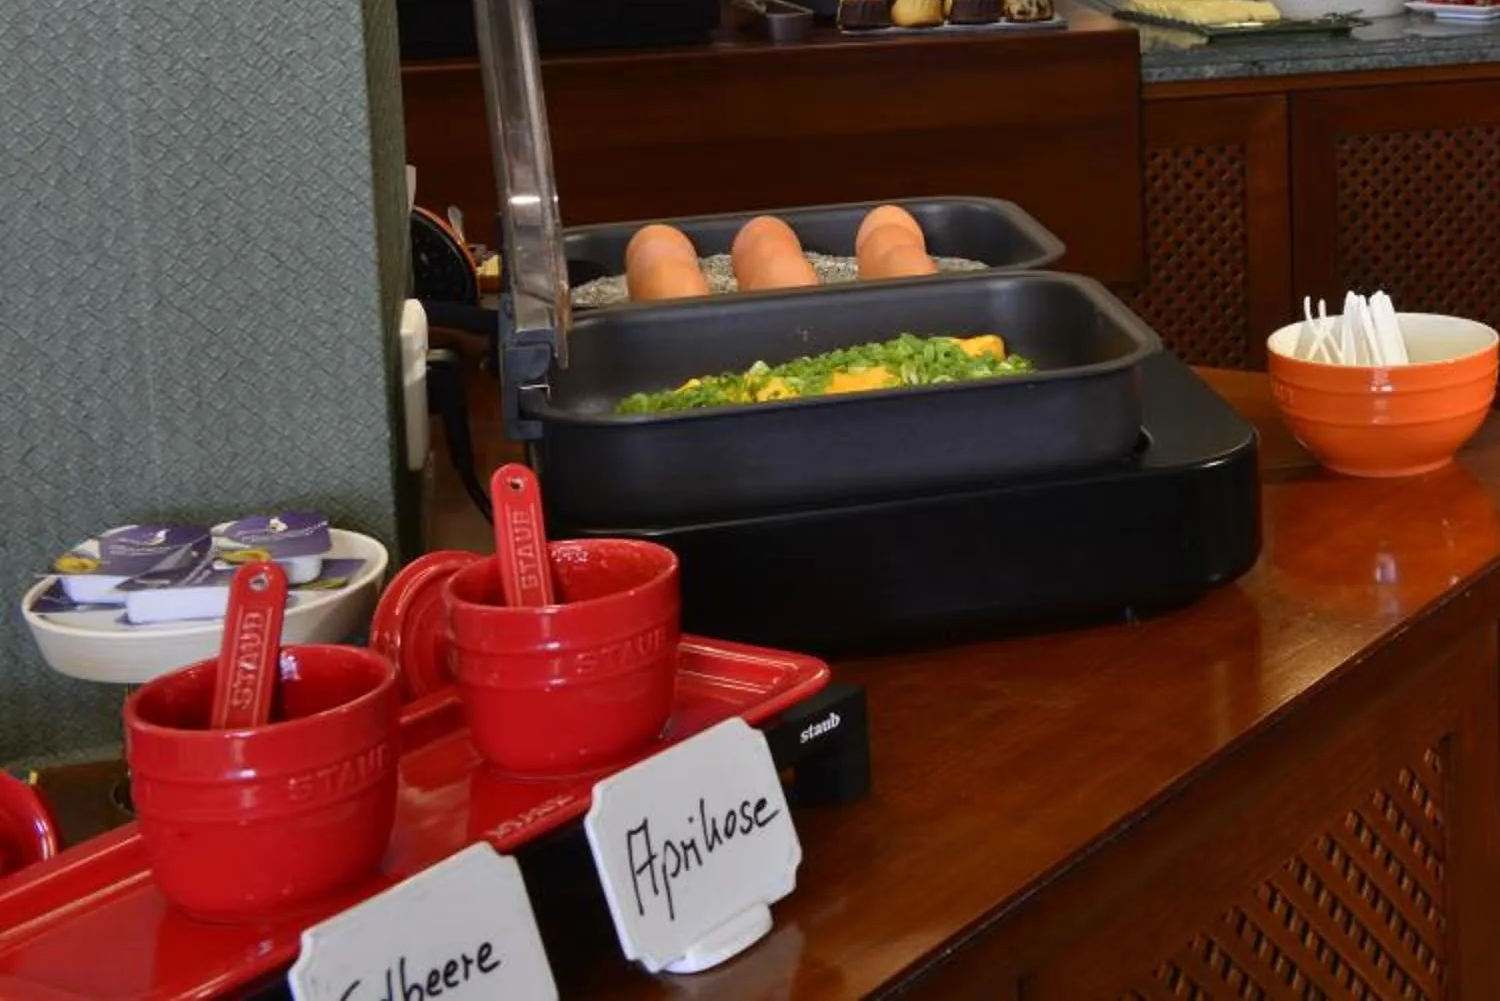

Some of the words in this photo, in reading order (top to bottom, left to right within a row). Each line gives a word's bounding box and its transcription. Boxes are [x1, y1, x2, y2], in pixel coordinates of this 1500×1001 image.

[511, 509, 540, 591] STAUB
[230, 610, 266, 711] STAUB
[799, 711, 841, 744] staub
[625, 796, 781, 921] Aprikose
[340, 941, 502, 1001] dbeere
